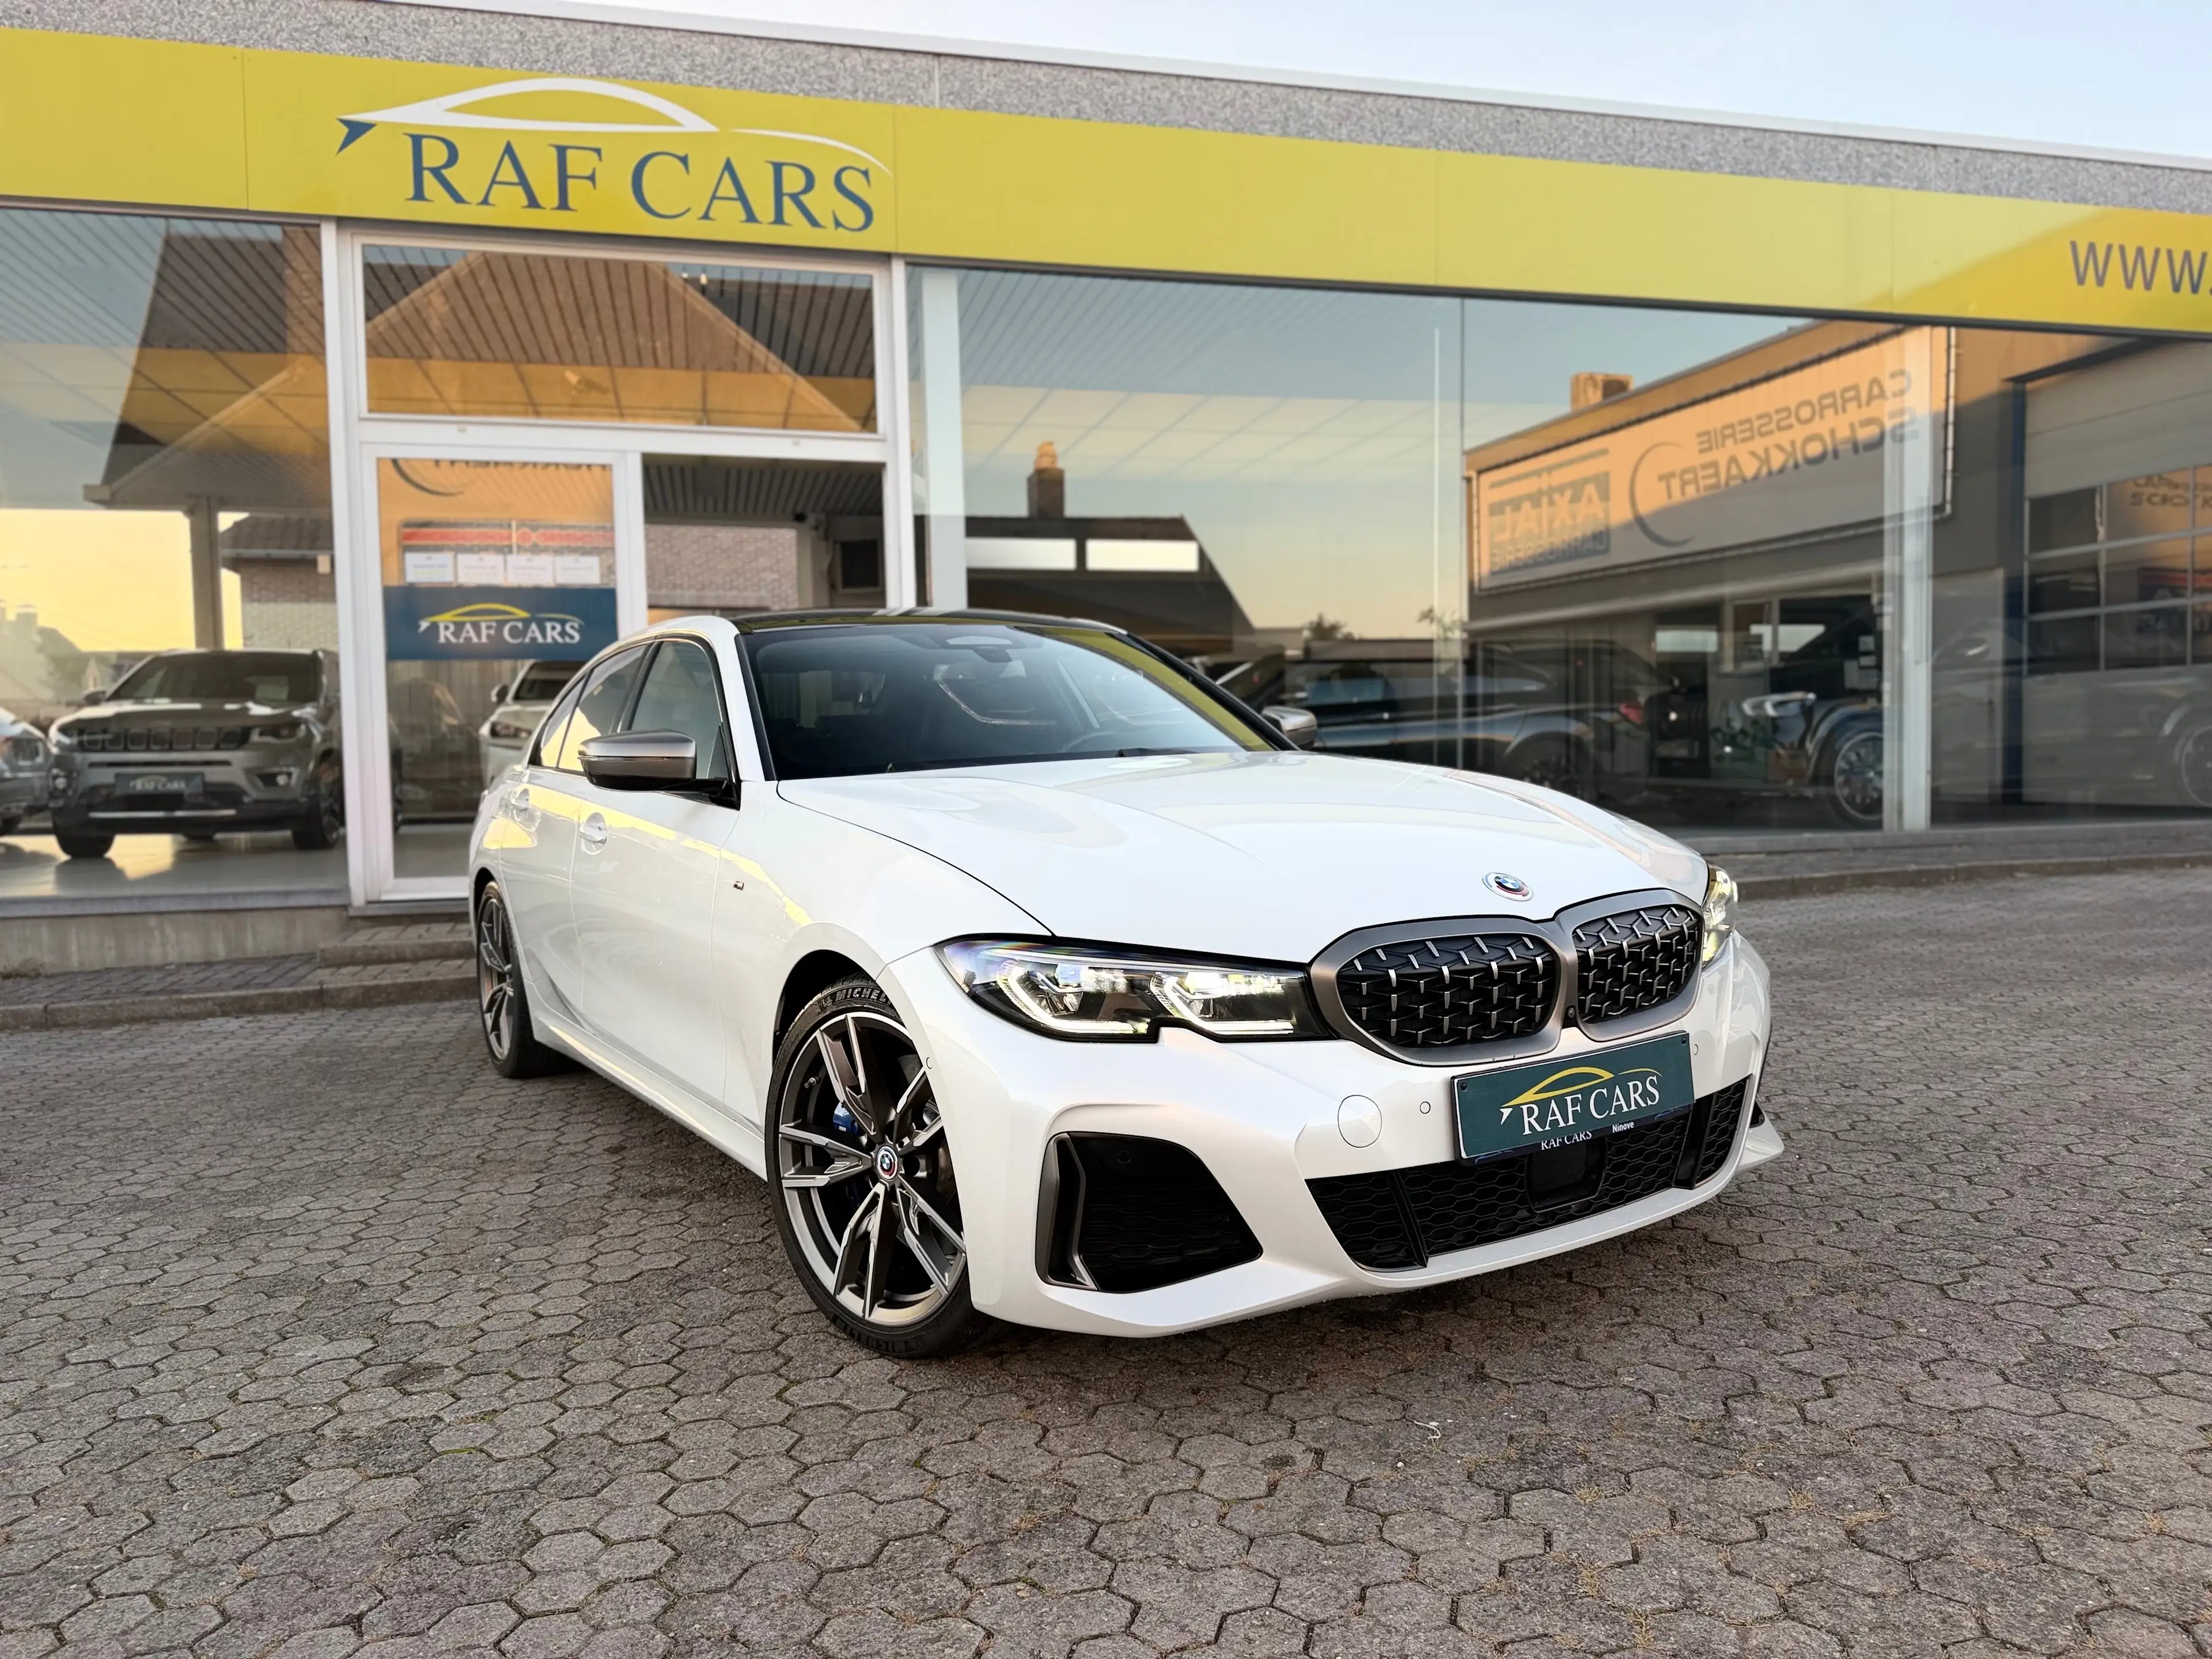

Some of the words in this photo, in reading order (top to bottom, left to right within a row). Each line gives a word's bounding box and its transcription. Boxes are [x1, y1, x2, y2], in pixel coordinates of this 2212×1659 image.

[403, 132, 603, 211] RAF
[630, 151, 874, 232] CARS
[438, 621, 497, 643] RAF
[503, 620, 581, 644] CARS
[1520, 1094, 1582, 1136] RAF
[1589, 1075, 1660, 1119] CARS
[1612, 1121, 1635, 1134] Ninove
[1541, 1138, 1562, 1150] RAF
[1564, 1130, 1592, 1145] CARS
